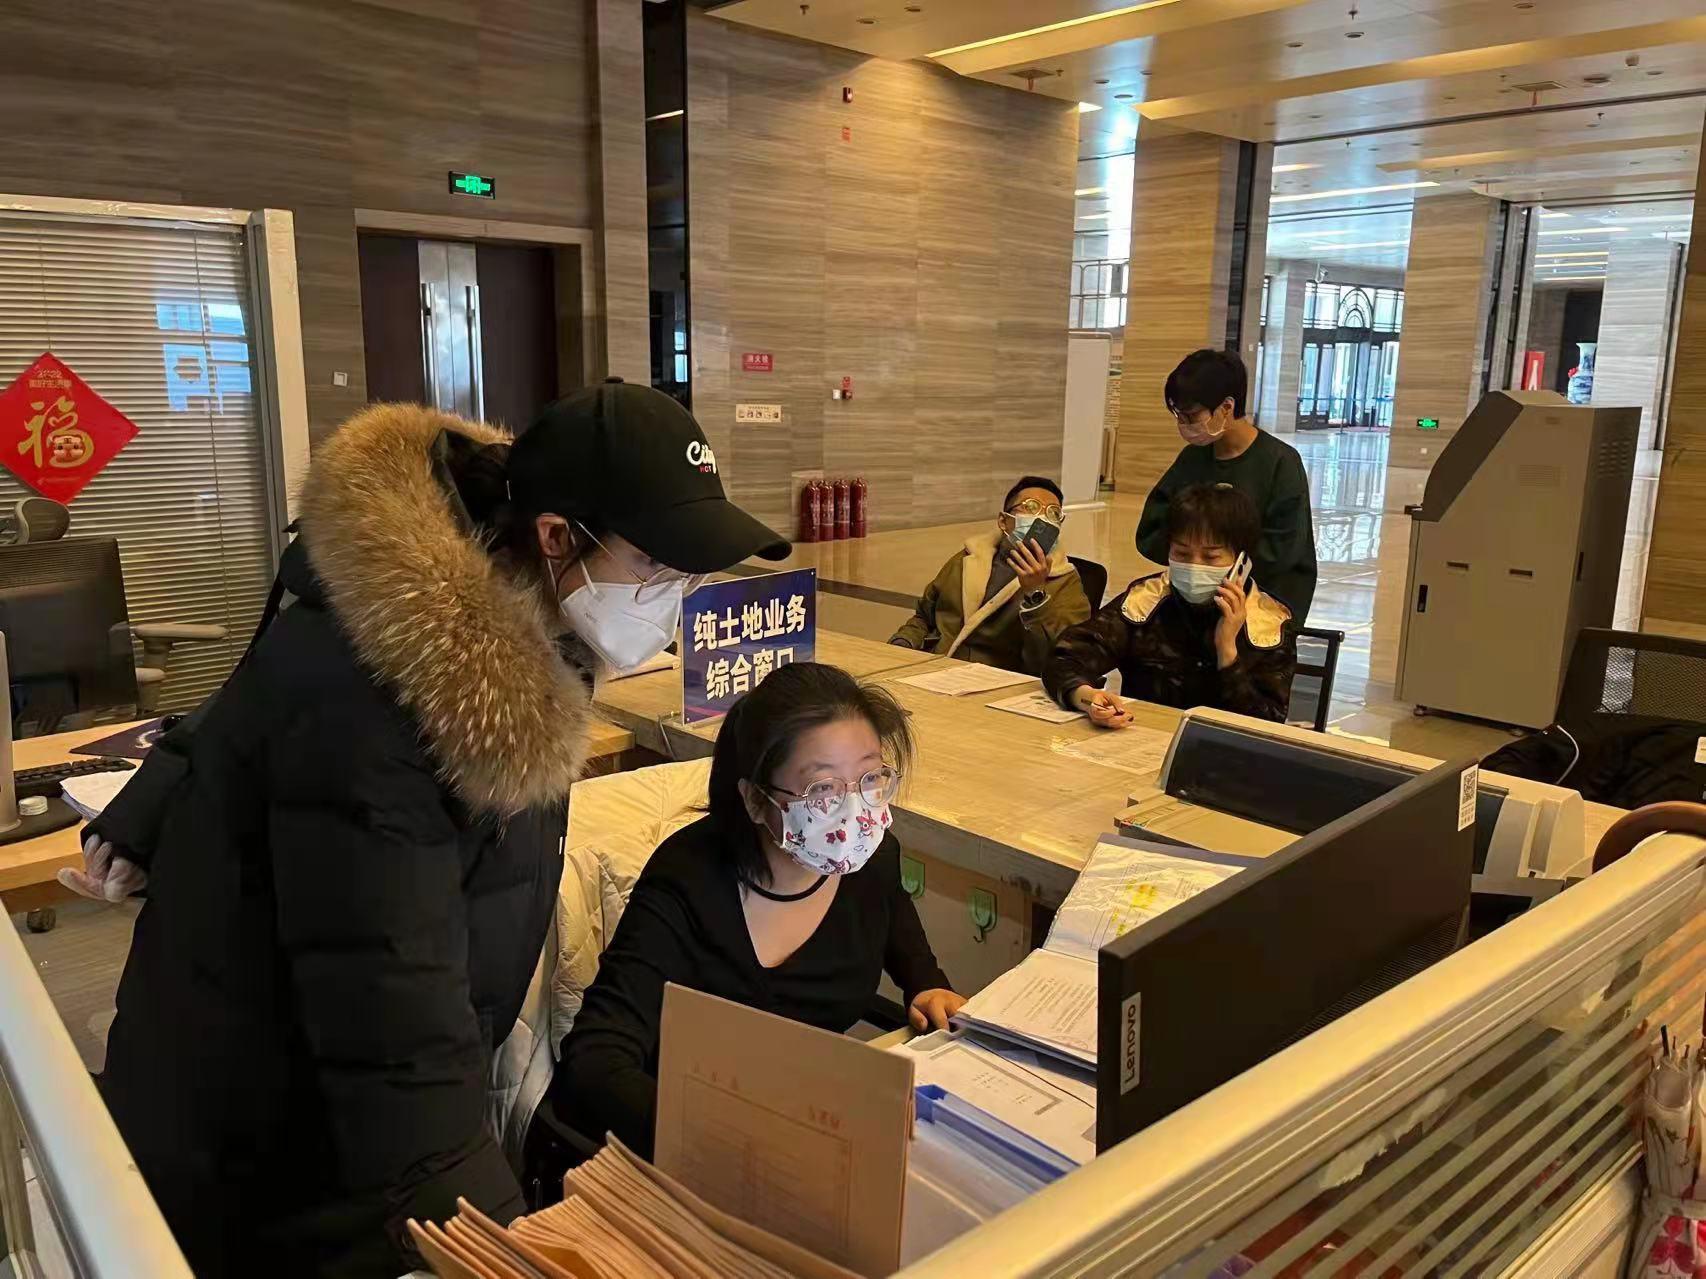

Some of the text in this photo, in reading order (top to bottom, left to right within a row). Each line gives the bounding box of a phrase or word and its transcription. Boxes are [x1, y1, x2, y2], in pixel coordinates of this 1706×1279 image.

[17, 396, 95, 468] 福
[693, 594, 806, 652] 纯土地业务
[1125, 1004, 1136, 1084] Lenovo
